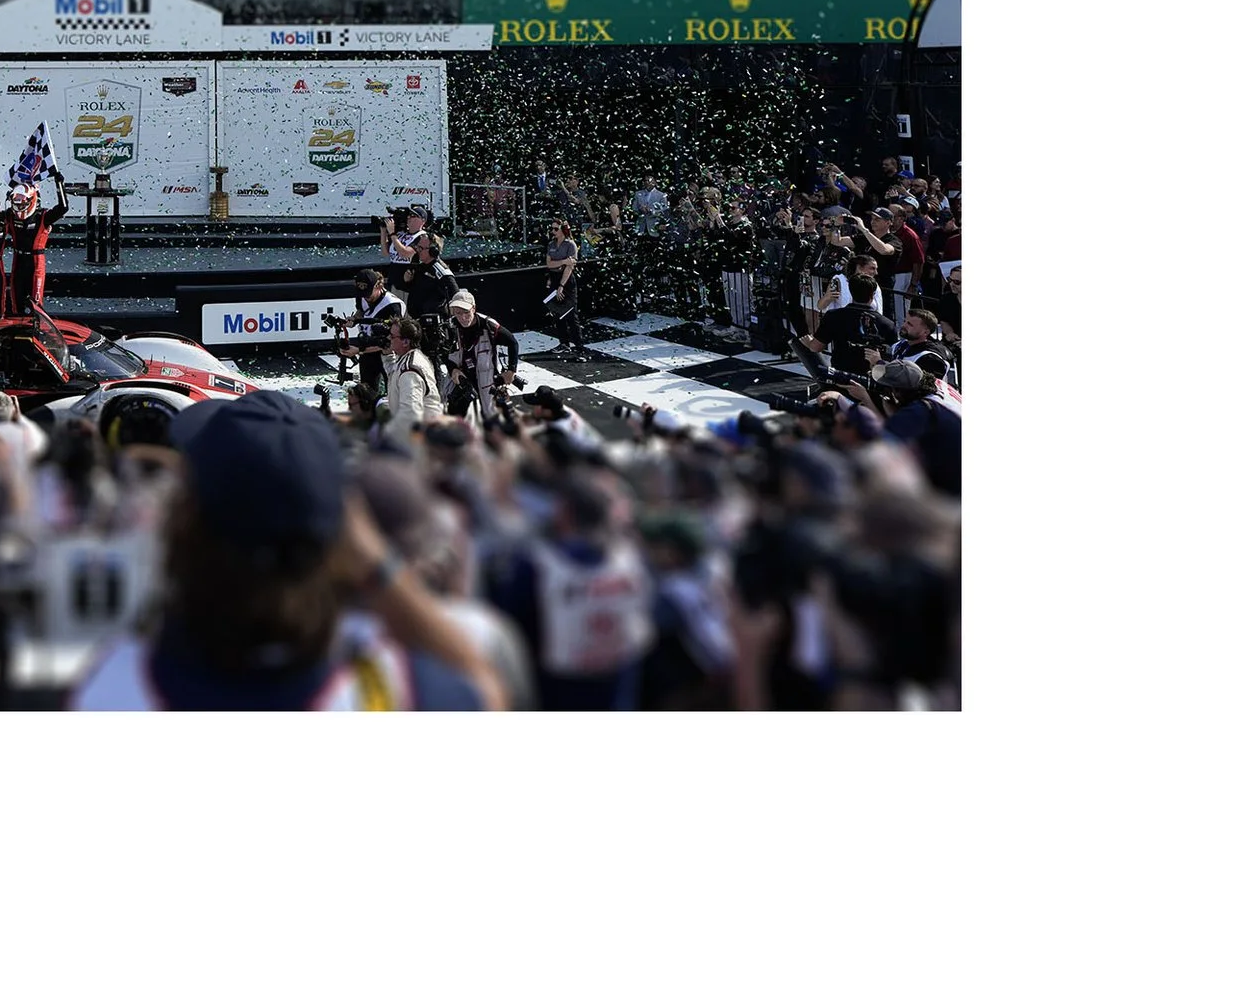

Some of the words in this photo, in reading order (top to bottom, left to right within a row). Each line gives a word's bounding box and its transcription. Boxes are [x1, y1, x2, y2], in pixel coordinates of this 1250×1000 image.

[500, 19, 614, 42] ROLEX
[685, 18, 796, 41] ROLEX
[56, 34, 112, 46] VICTORY
[116, 34, 151, 46] LANE
[270, 31, 315, 45] Mobil
[355, 32, 413, 44] VICTORY
[416, 32, 450, 43] LANE
[7, 85, 49, 93] DAYTONA
[80, 101, 126, 111] ROLEX
[73, 115, 134, 137] 24
[313, 118, 350, 127] ROLEX
[308, 130, 356, 147] 24
[312, 154, 353, 162] DAYTONA
[224, 312, 286, 334] Mobil
